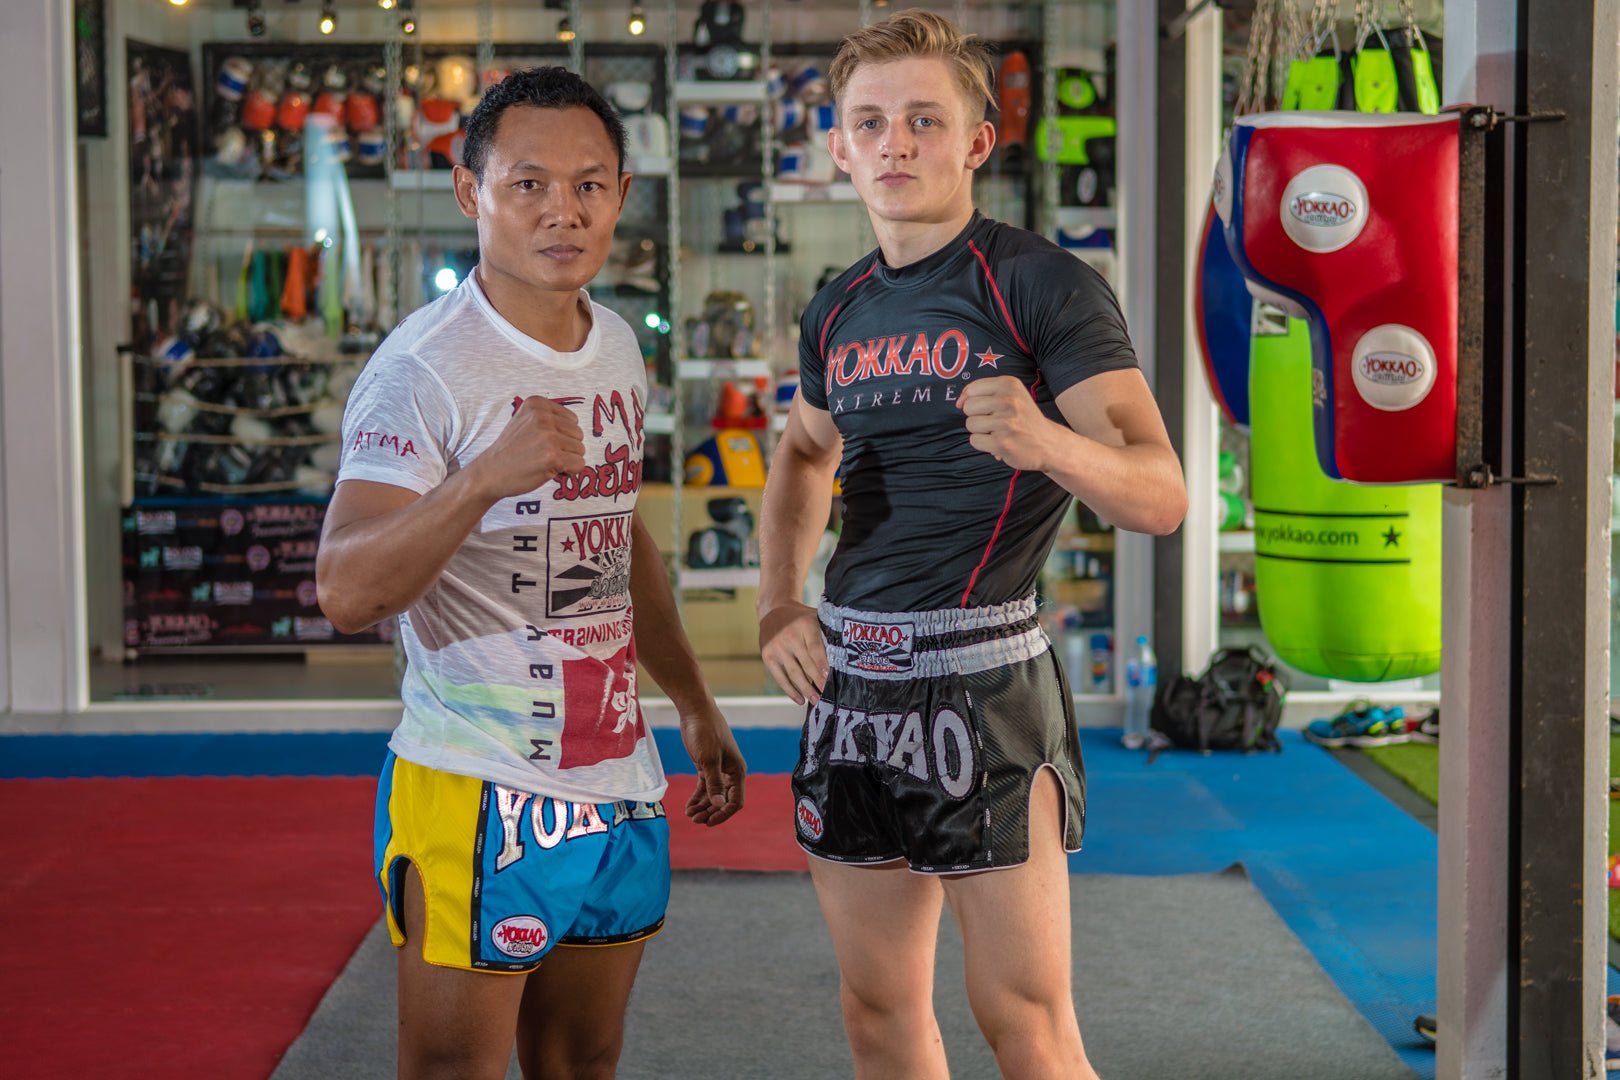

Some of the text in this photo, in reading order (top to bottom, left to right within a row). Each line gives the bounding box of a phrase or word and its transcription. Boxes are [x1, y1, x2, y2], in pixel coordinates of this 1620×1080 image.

[1296, 196, 1349, 218] YOKKAO
[826, 328, 969, 396] YOKKAO
[1365, 355, 1417, 378] YOKKAO
[834, 384, 957, 414] XTREME
[353, 431, 420, 460] ATMA
[571, 515, 631, 561] YOKK
[848, 622, 903, 646] YOKKAO
[502, 924, 543, 947] YOKKAO
